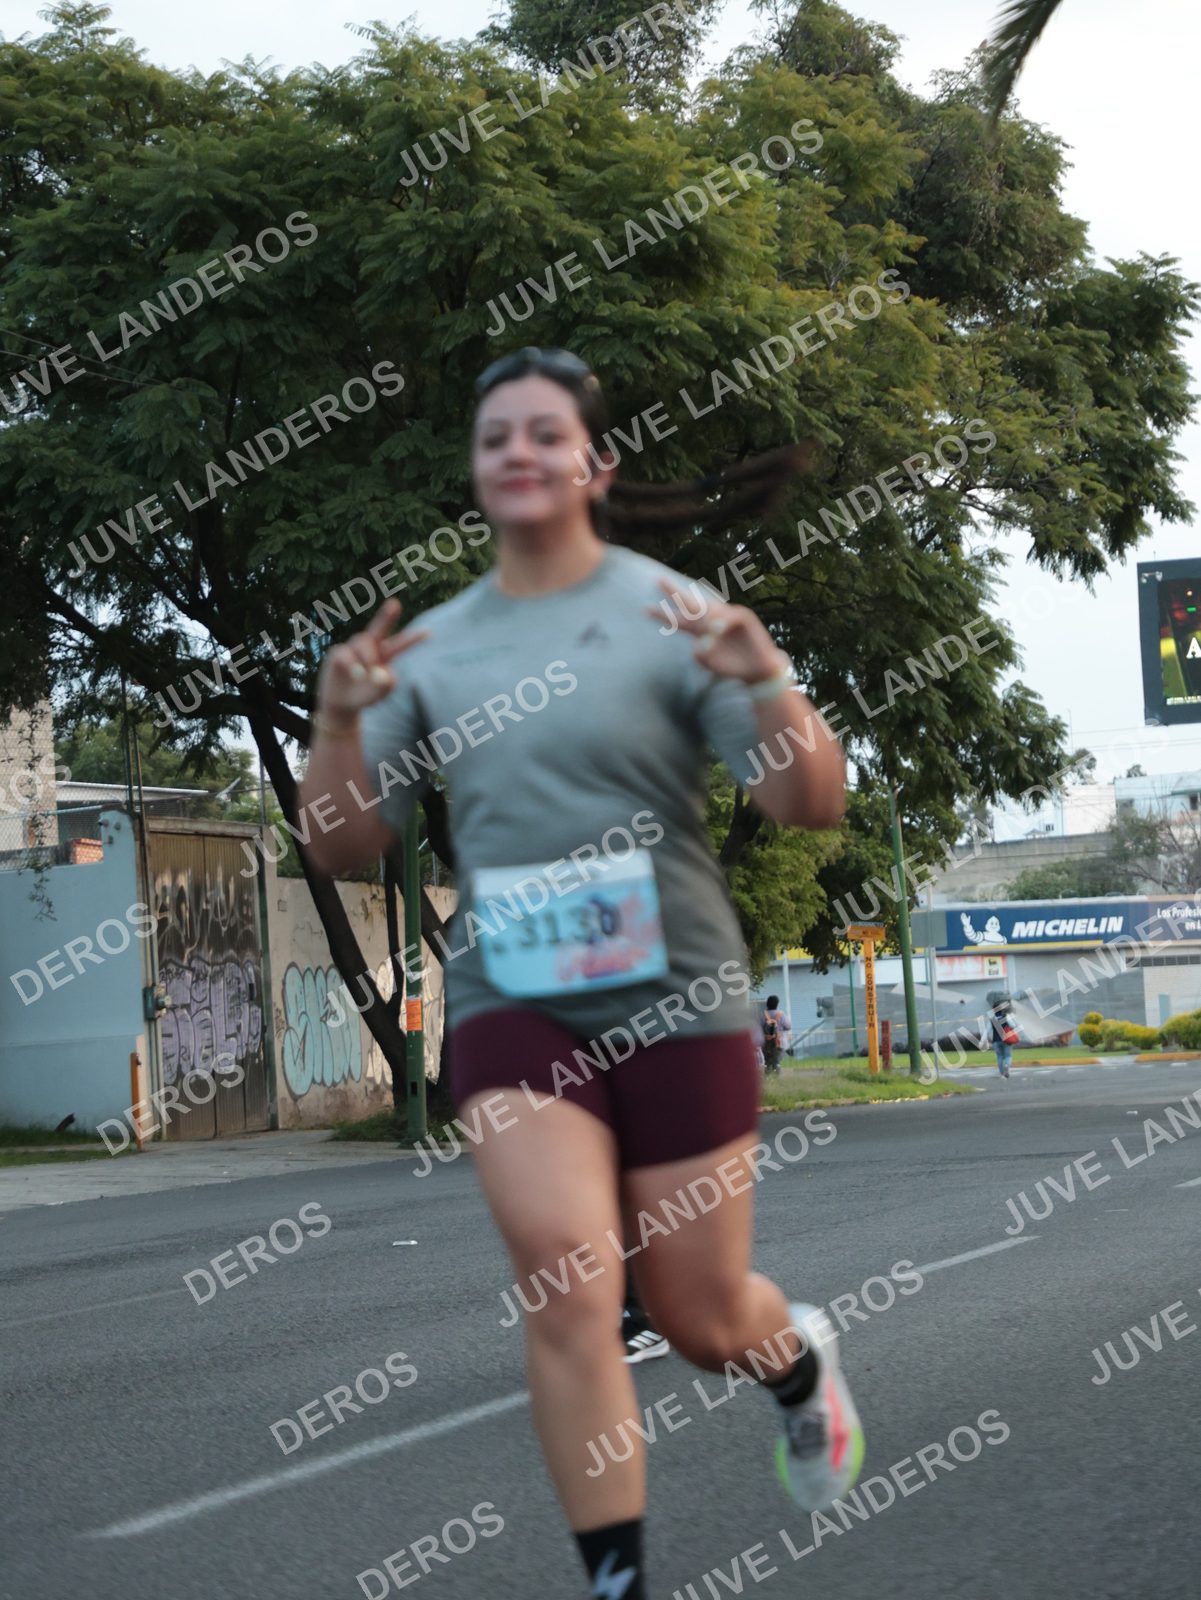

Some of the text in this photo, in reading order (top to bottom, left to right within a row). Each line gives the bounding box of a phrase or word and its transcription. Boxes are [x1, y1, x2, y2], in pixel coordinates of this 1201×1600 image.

[1011, 916, 1123, 938] MICHELIN
[865, 956, 875, 1029] NO CONSTRUIR
